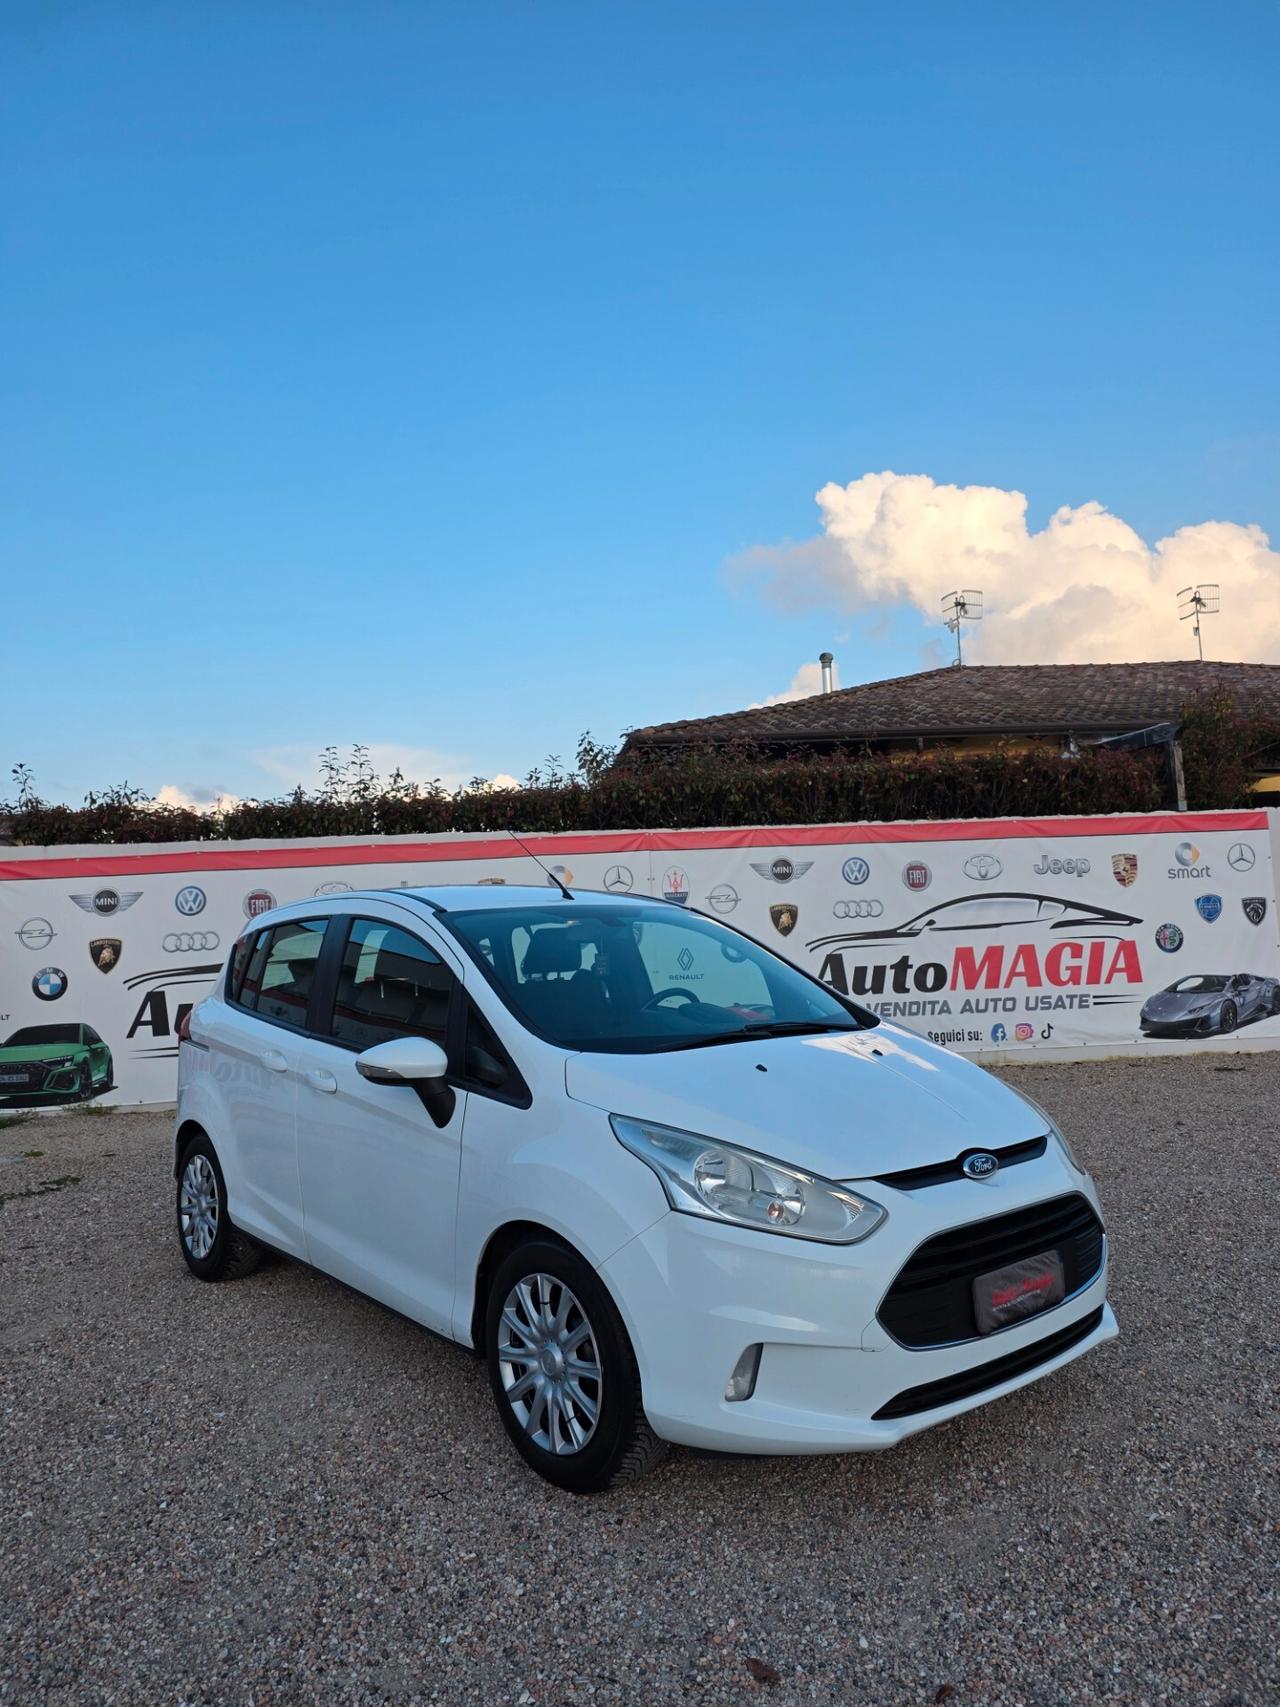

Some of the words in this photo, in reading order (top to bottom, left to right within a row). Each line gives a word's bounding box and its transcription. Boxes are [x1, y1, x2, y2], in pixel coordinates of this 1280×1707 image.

[773, 866, 792, 874] MINI
[1033, 854, 1091, 878] Jeep
[1167, 865, 1211, 879] smart
[908, 869, 926, 885] FIAT
[95, 897, 119, 907] MINI
[250, 899, 271, 914] FIAT
[817, 940, 1144, 997] AutoMAGIA
[668, 973, 705, 981] RENAULT
[865, 1000, 952, 1018] VENDITA
[960, 997, 1017, 1014] AUTO
[1025, 994, 1091, 1011] USATE
[967, 1030, 983, 1041] su:
[973, 1156, 993, 1173] Ford
